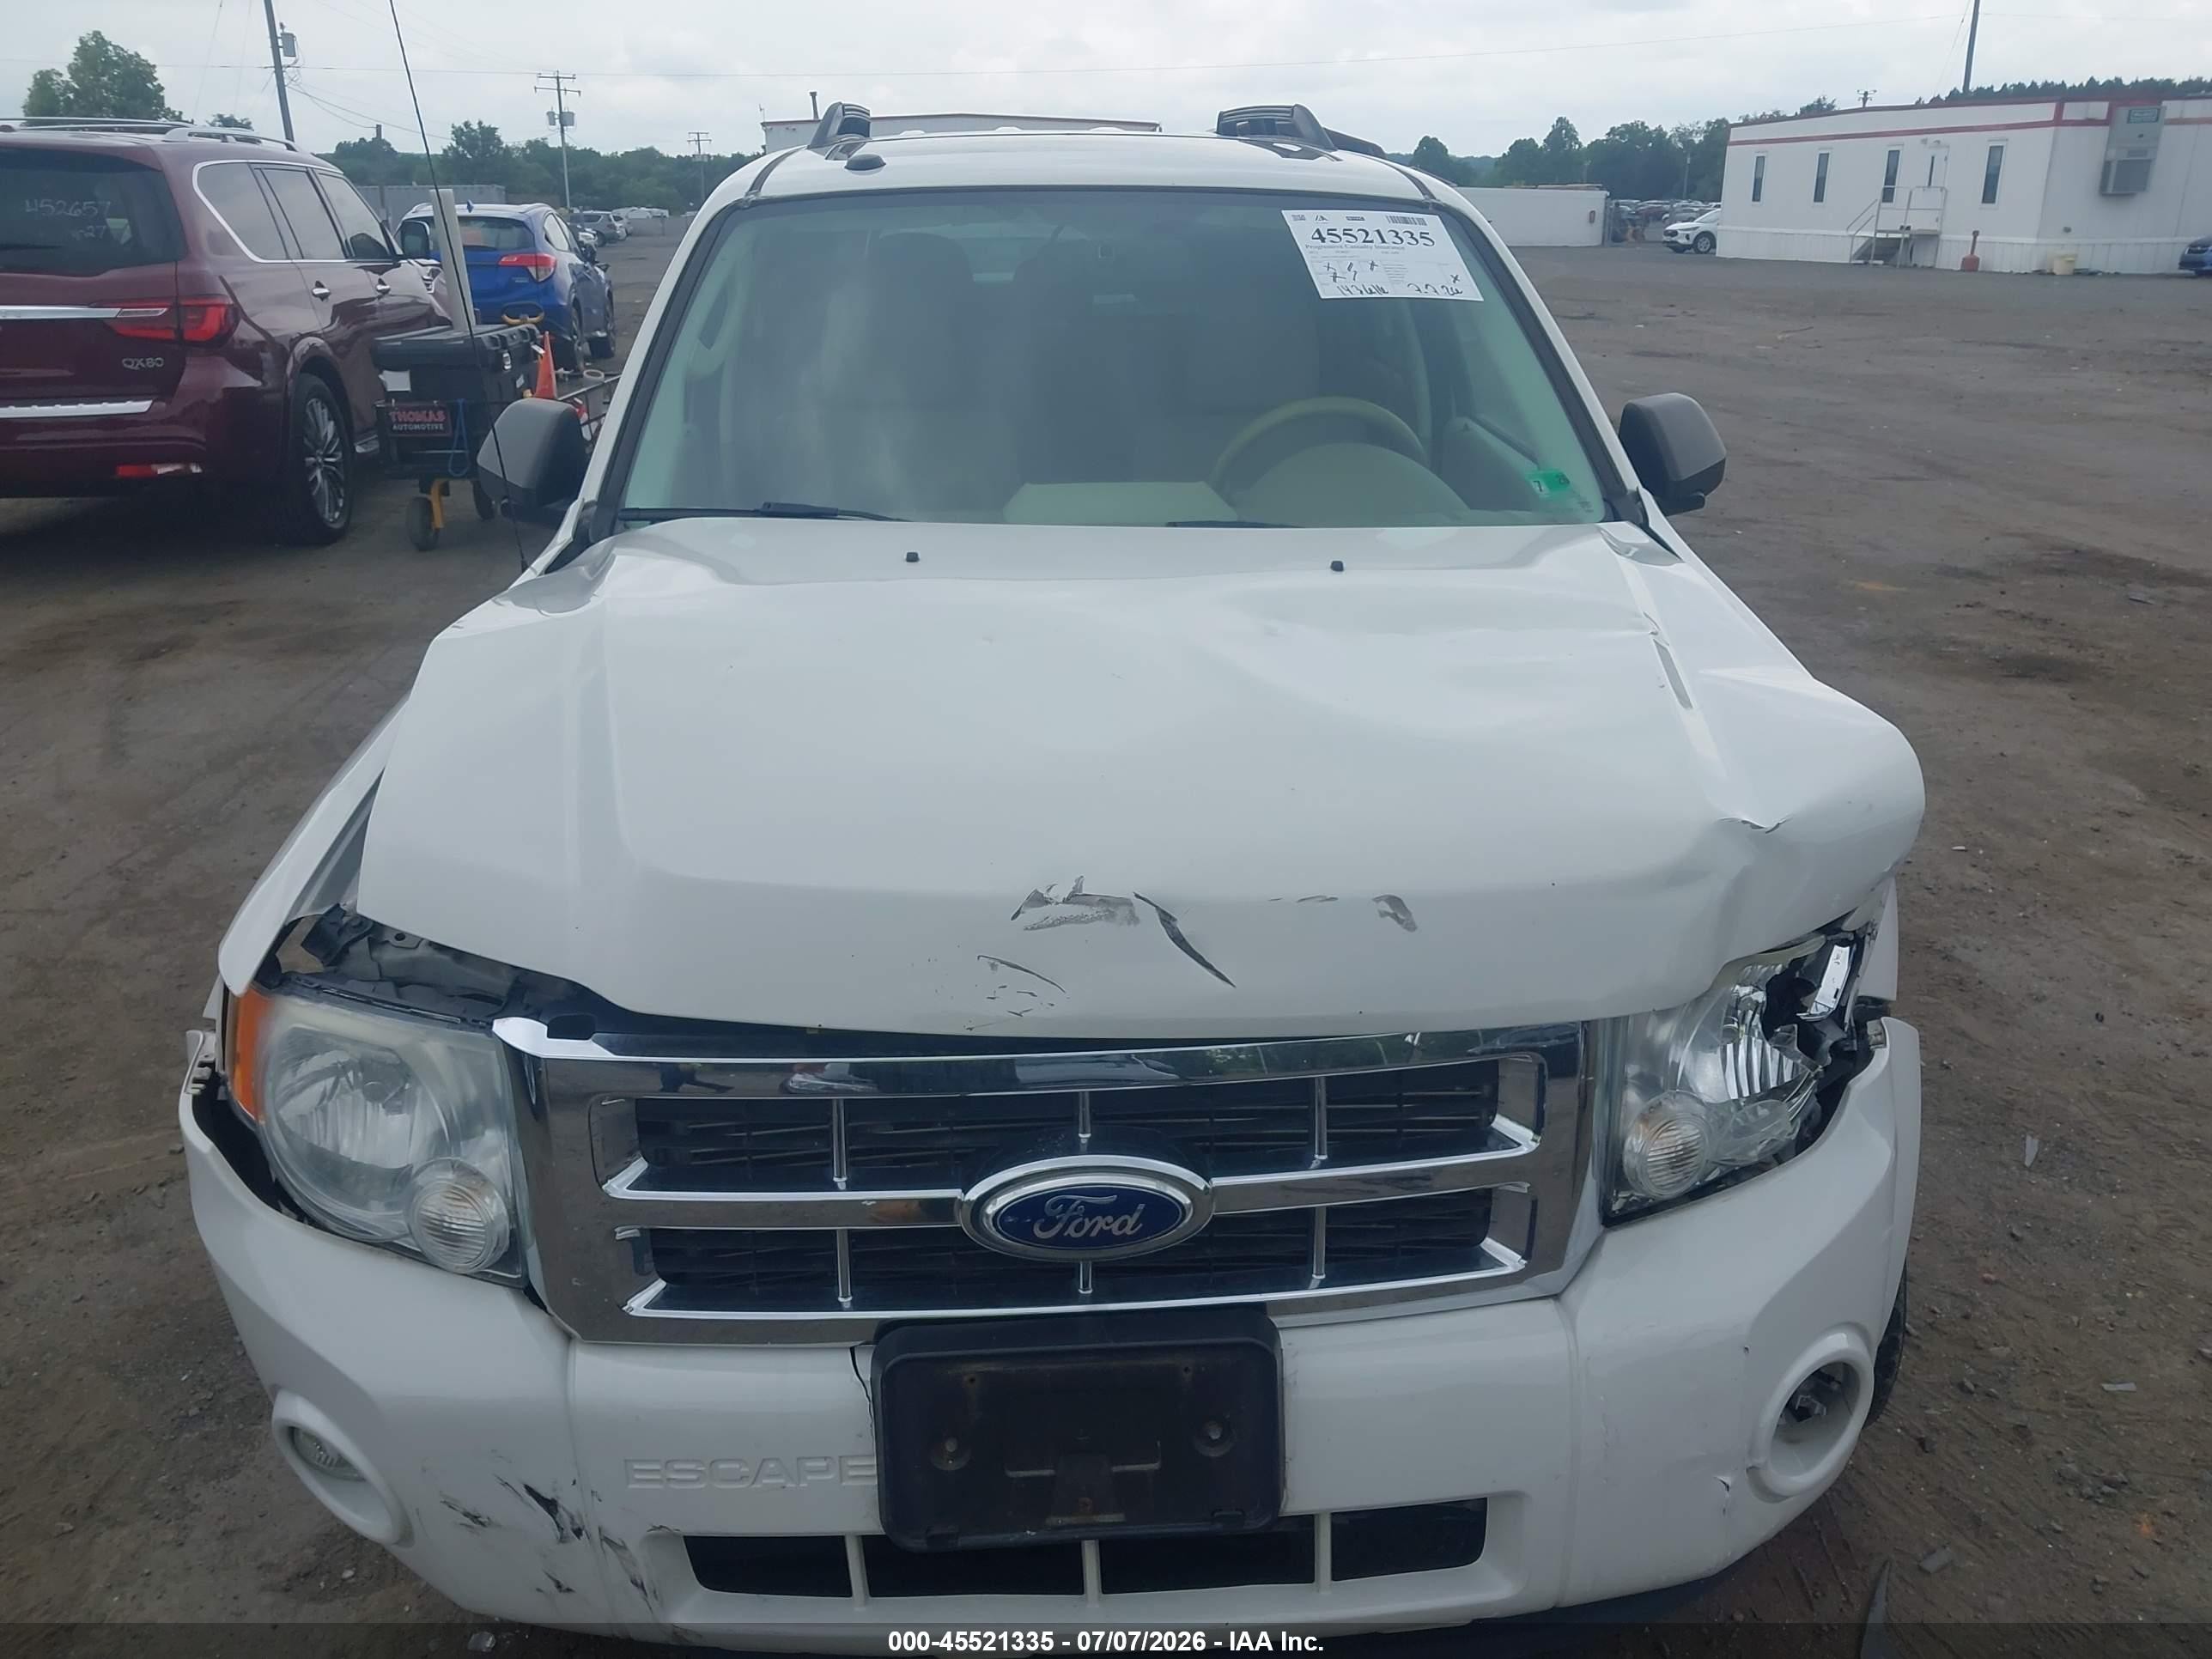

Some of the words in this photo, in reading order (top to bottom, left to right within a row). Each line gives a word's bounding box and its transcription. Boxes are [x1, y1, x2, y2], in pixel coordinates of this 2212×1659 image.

[1311, 228, 1435, 246] 45521335
[122, 357, 164, 370] QX80
[391, 410, 446, 422] THOMAS
[1032, 1194, 1146, 1240] Ford
[624, 1455, 878, 1490] ESCAPE
